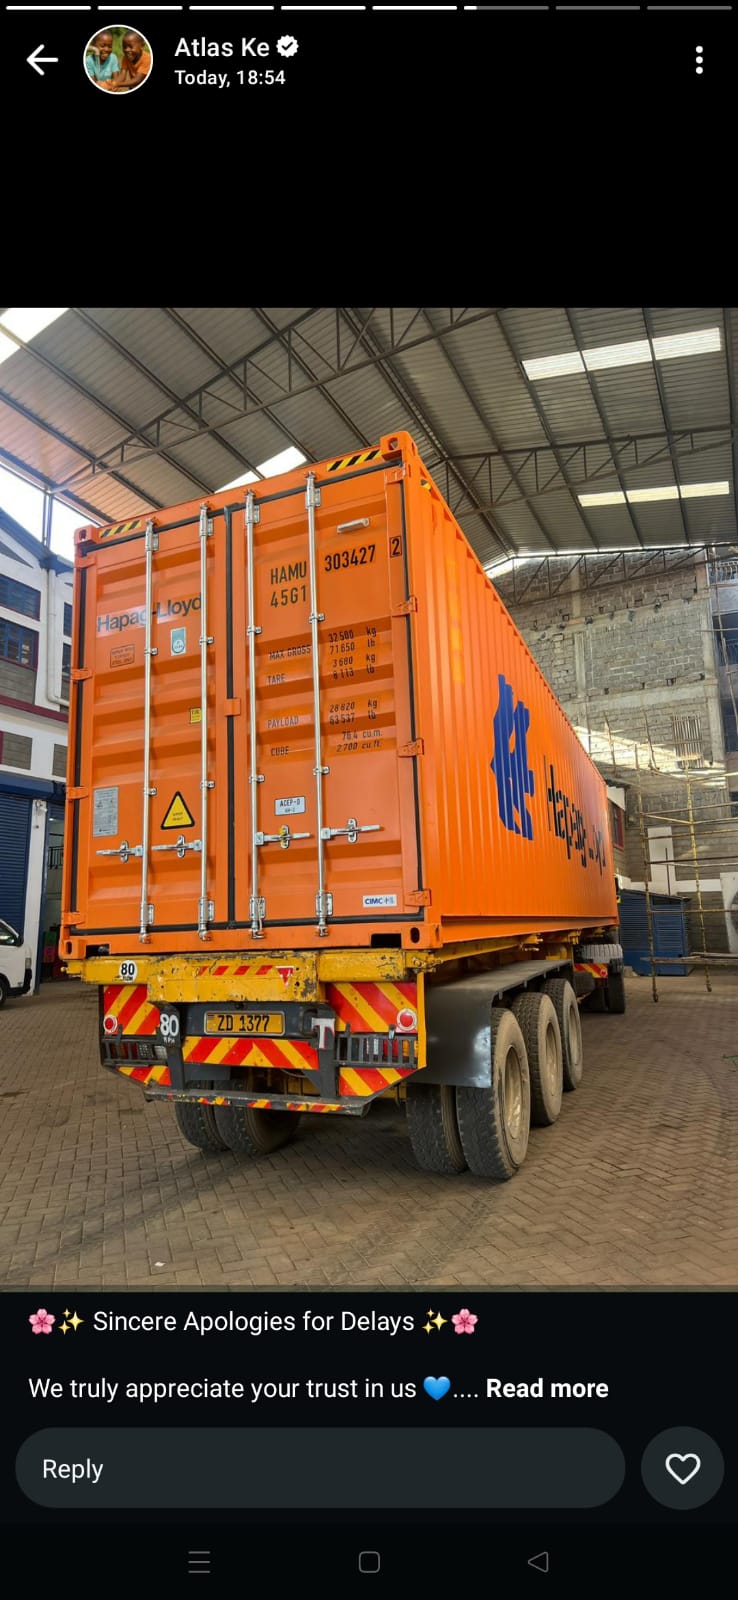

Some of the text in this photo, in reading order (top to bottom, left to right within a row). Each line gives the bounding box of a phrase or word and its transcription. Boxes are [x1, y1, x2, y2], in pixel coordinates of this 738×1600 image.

[270, 538, 400, 584] HAMU 303427 2
[270, 585, 306, 608] 45G1
[267, 715, 298, 729] PAYLOAD
[121, 963, 135, 976] 80
[160, 1013, 179, 1037] 80
[217, 1014, 270, 1033] ZD 1377
